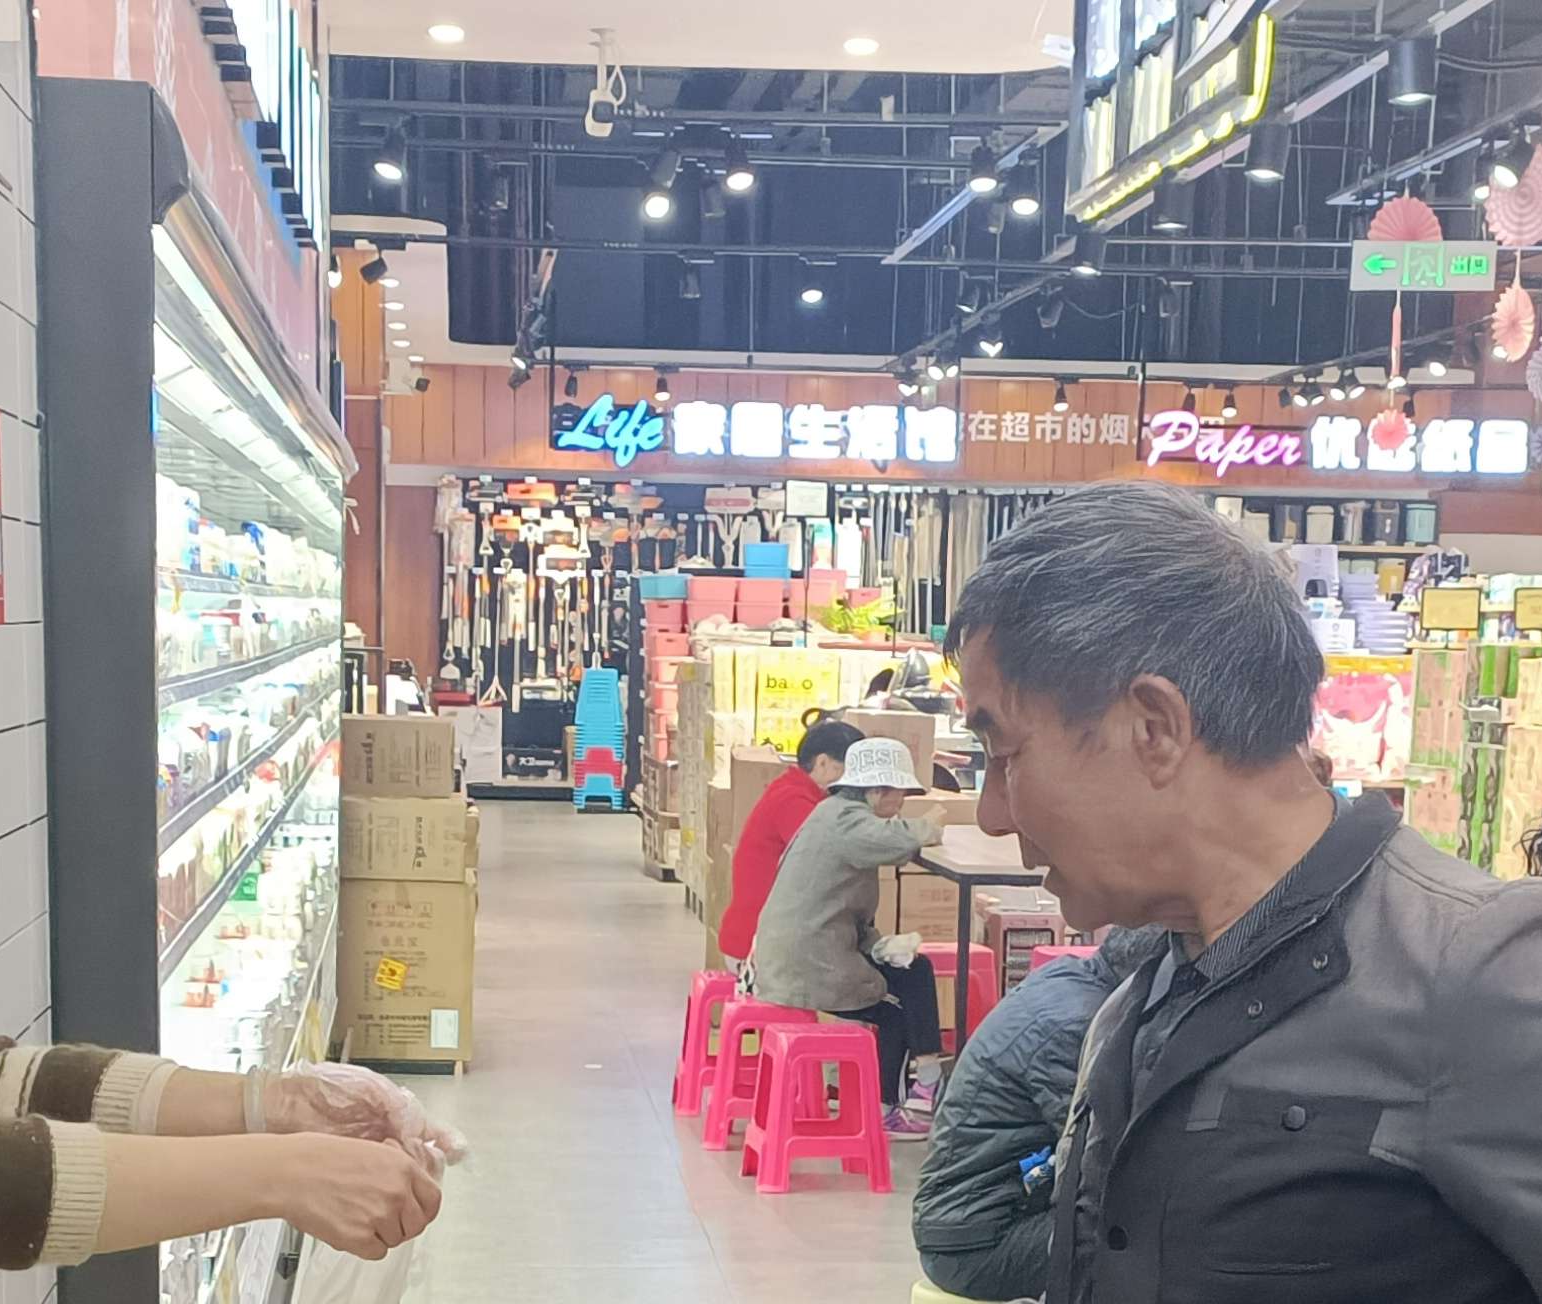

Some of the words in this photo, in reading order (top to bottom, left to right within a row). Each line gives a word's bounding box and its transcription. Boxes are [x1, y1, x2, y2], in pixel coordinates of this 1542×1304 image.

[1450, 255, 1489, 275] 出口
[558, 393, 664, 468] Life
[1146, 410, 1302, 478] Paper
